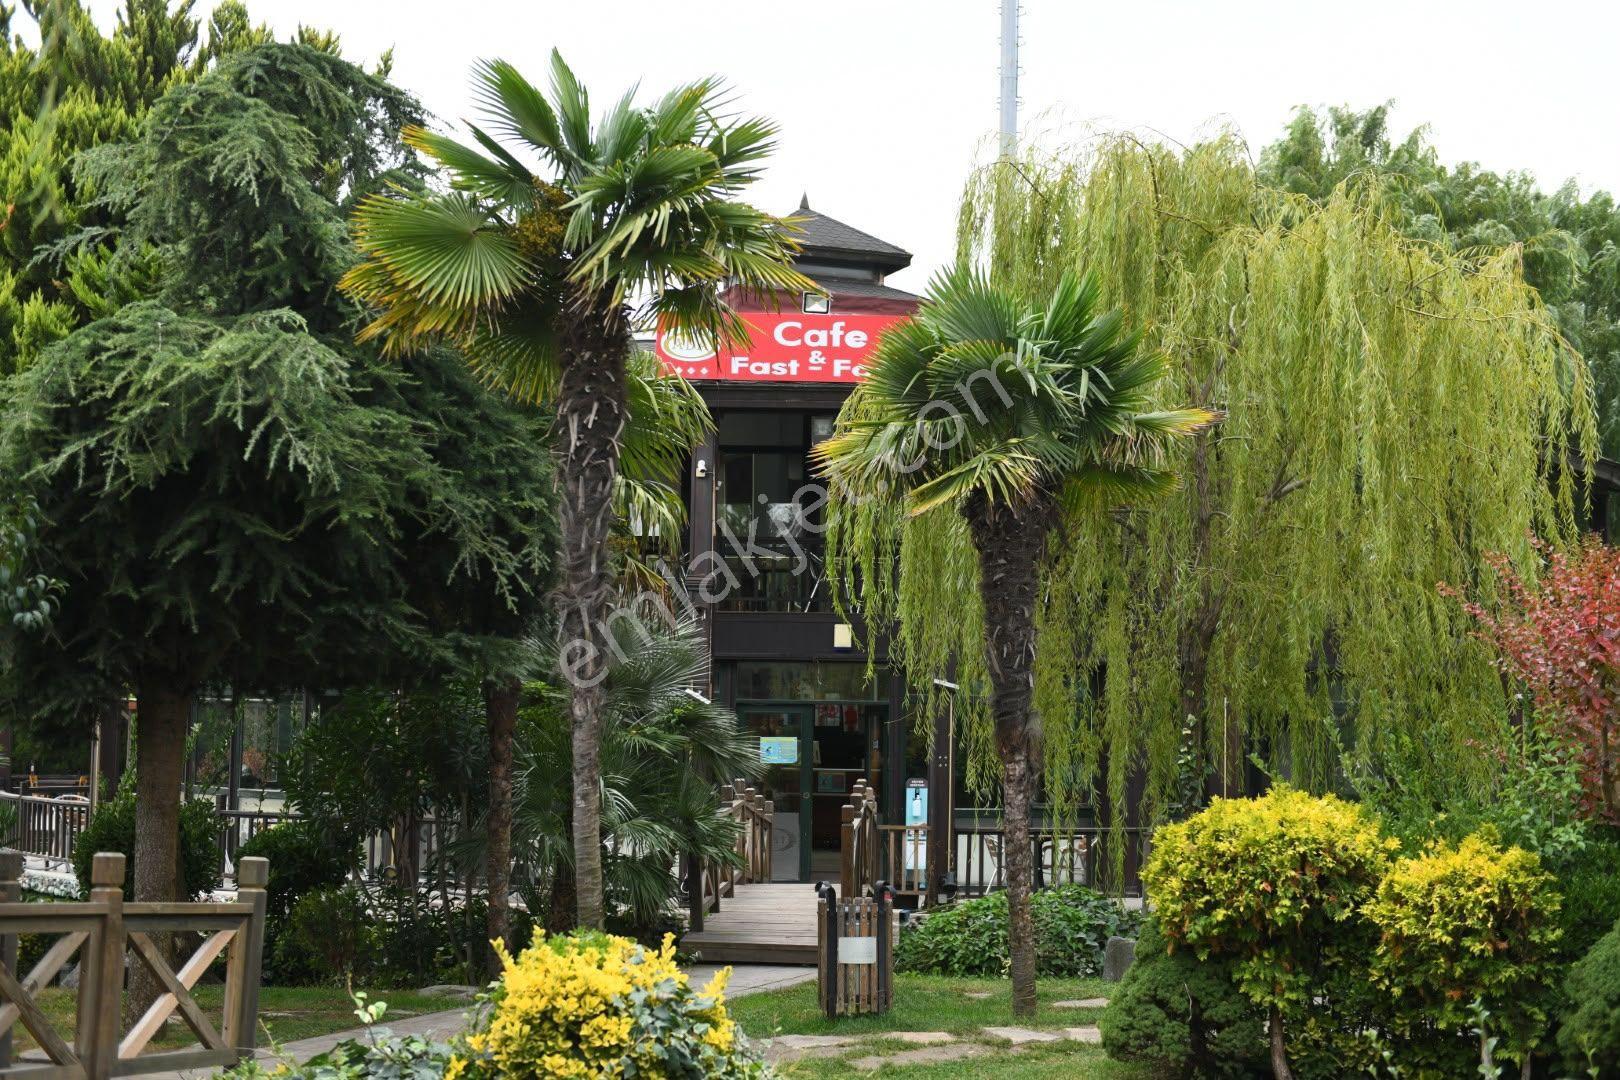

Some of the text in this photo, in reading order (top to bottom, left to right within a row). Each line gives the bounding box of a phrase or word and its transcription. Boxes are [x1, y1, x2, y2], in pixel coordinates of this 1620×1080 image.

[773, 321, 868, 348] Cafe
[730, 356, 872, 377] Fast Fo
[808, 350, 827, 365] &
